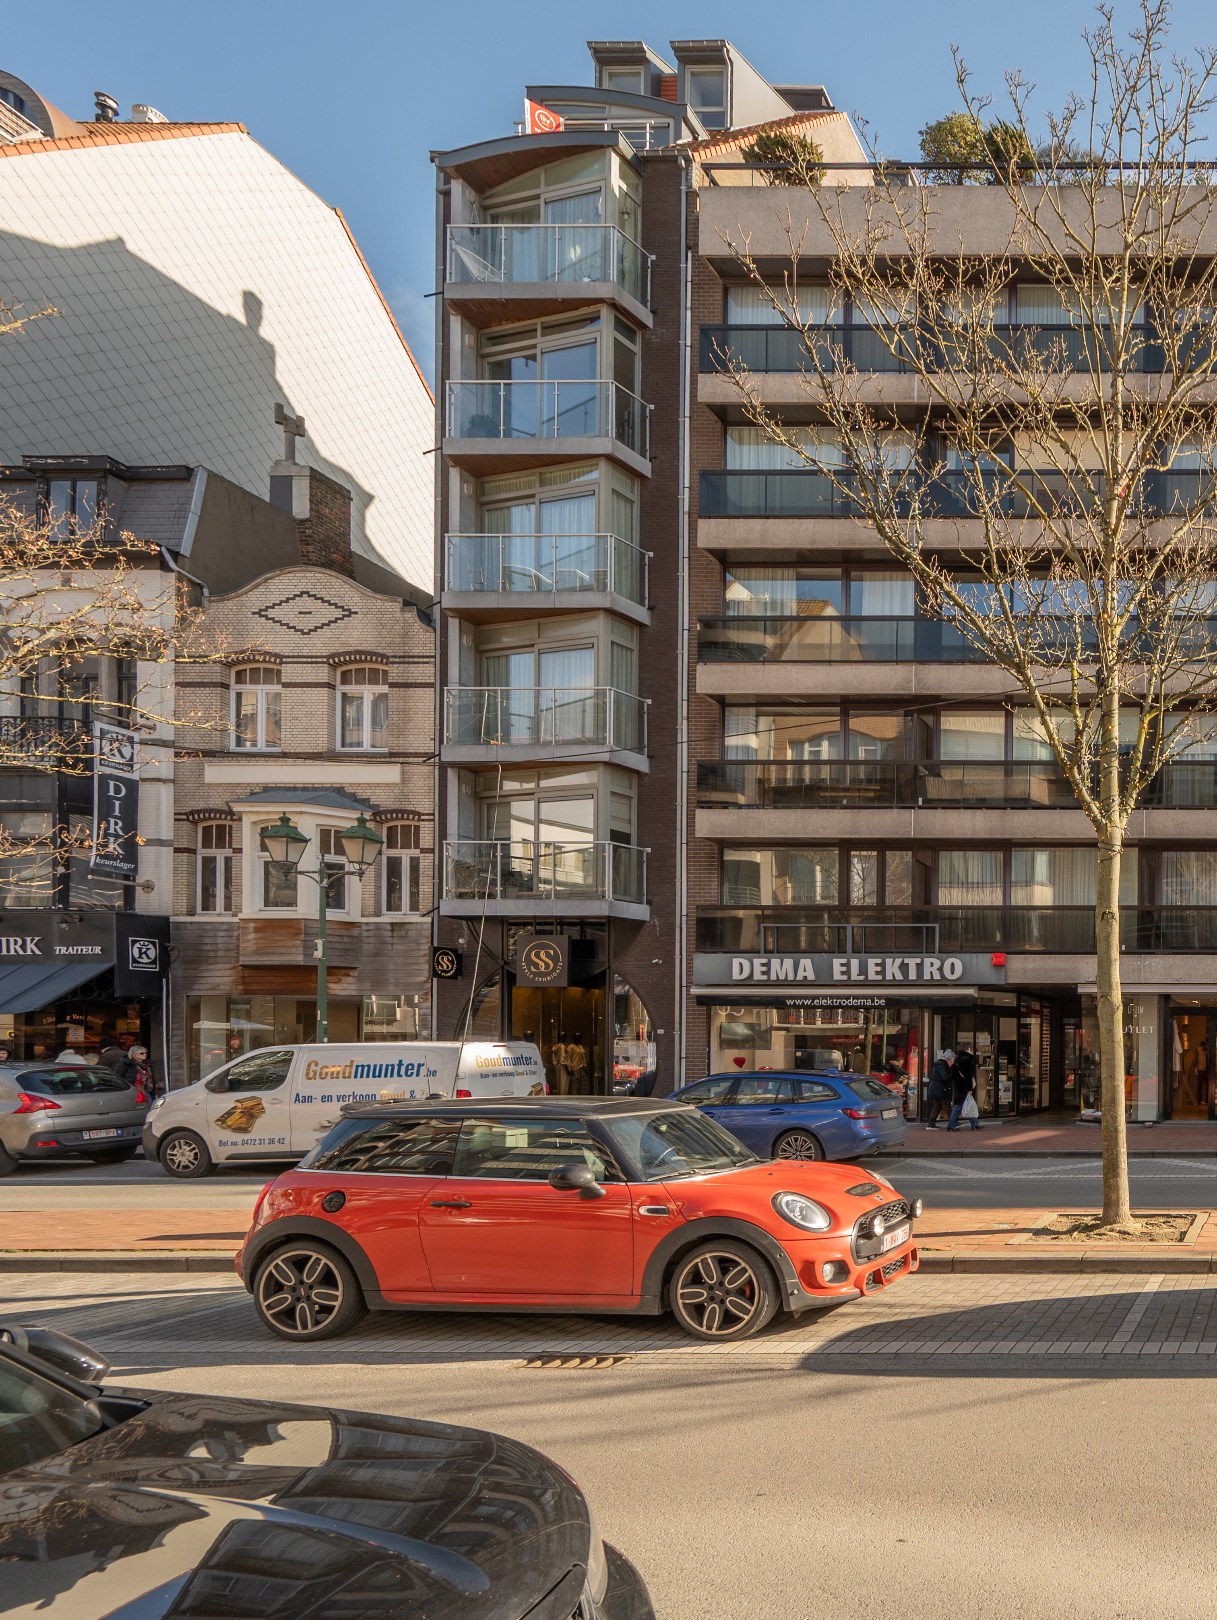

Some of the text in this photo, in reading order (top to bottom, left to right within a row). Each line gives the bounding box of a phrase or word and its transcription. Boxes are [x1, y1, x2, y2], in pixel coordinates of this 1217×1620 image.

[107, 779, 127, 855] DIRK
[95, 855, 136, 870] keurslager
[54, 946, 102, 955] TRAITEUR
[732, 957, 963, 981] DEMA ELEKTRO
[786, 997, 886, 1006] www.elektrodema.be
[1122, 1026, 1155, 1034] UTLET
[305, 1059, 437, 1080] Goudmunter.be
[294, 1092, 318, 1104] Aan-
[321, 1094, 332, 1103] en
[241, 1138, 257, 1146] 0472
[268, 1137, 276, 1145] 36
[277, 1137, 286, 1145] 42
